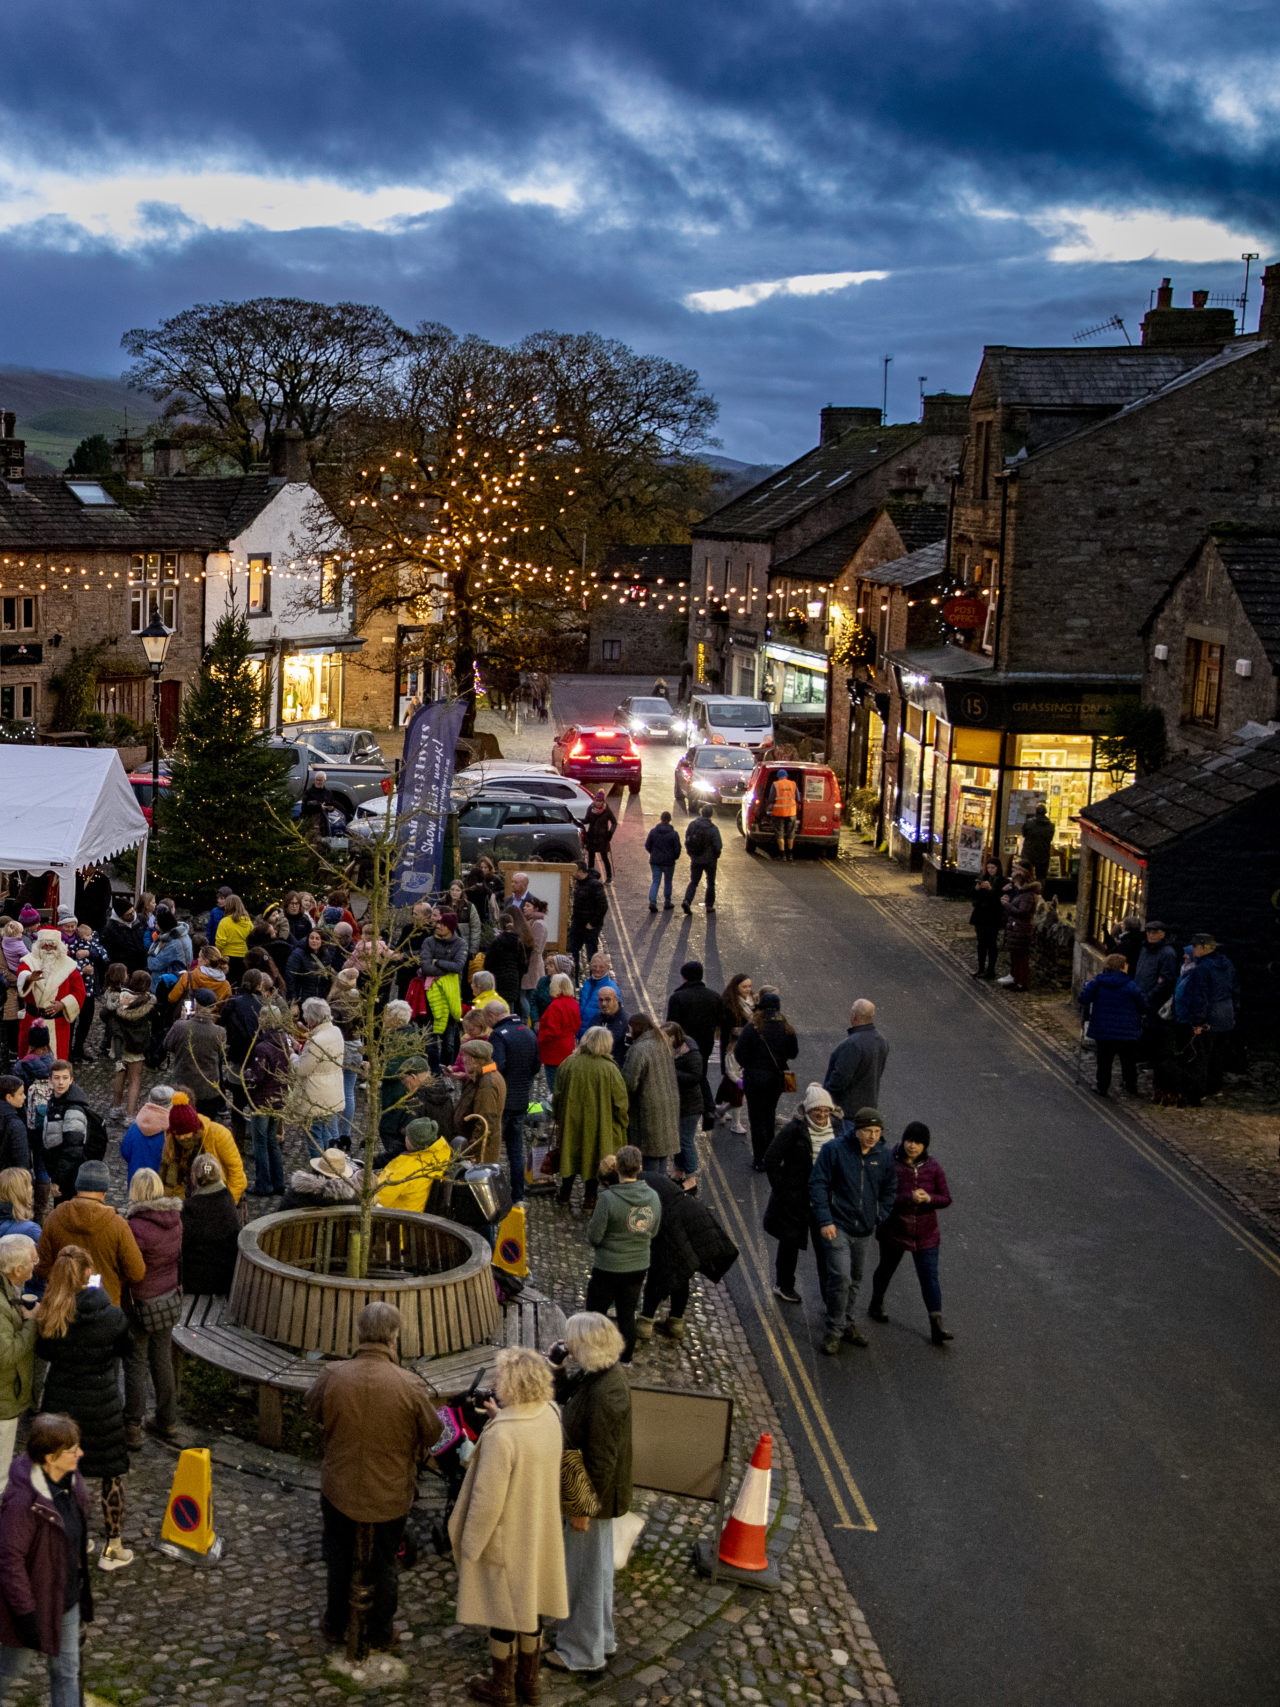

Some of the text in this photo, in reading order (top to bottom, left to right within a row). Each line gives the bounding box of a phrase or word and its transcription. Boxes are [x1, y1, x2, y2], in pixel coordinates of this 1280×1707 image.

[954, 606, 976, 616] POST
[967, 699, 982, 715] 15
[1012, 702, 1100, 713] GRASSINGTON
[421, 821, 437, 855] Show
[432, 738, 444, 780] week!
